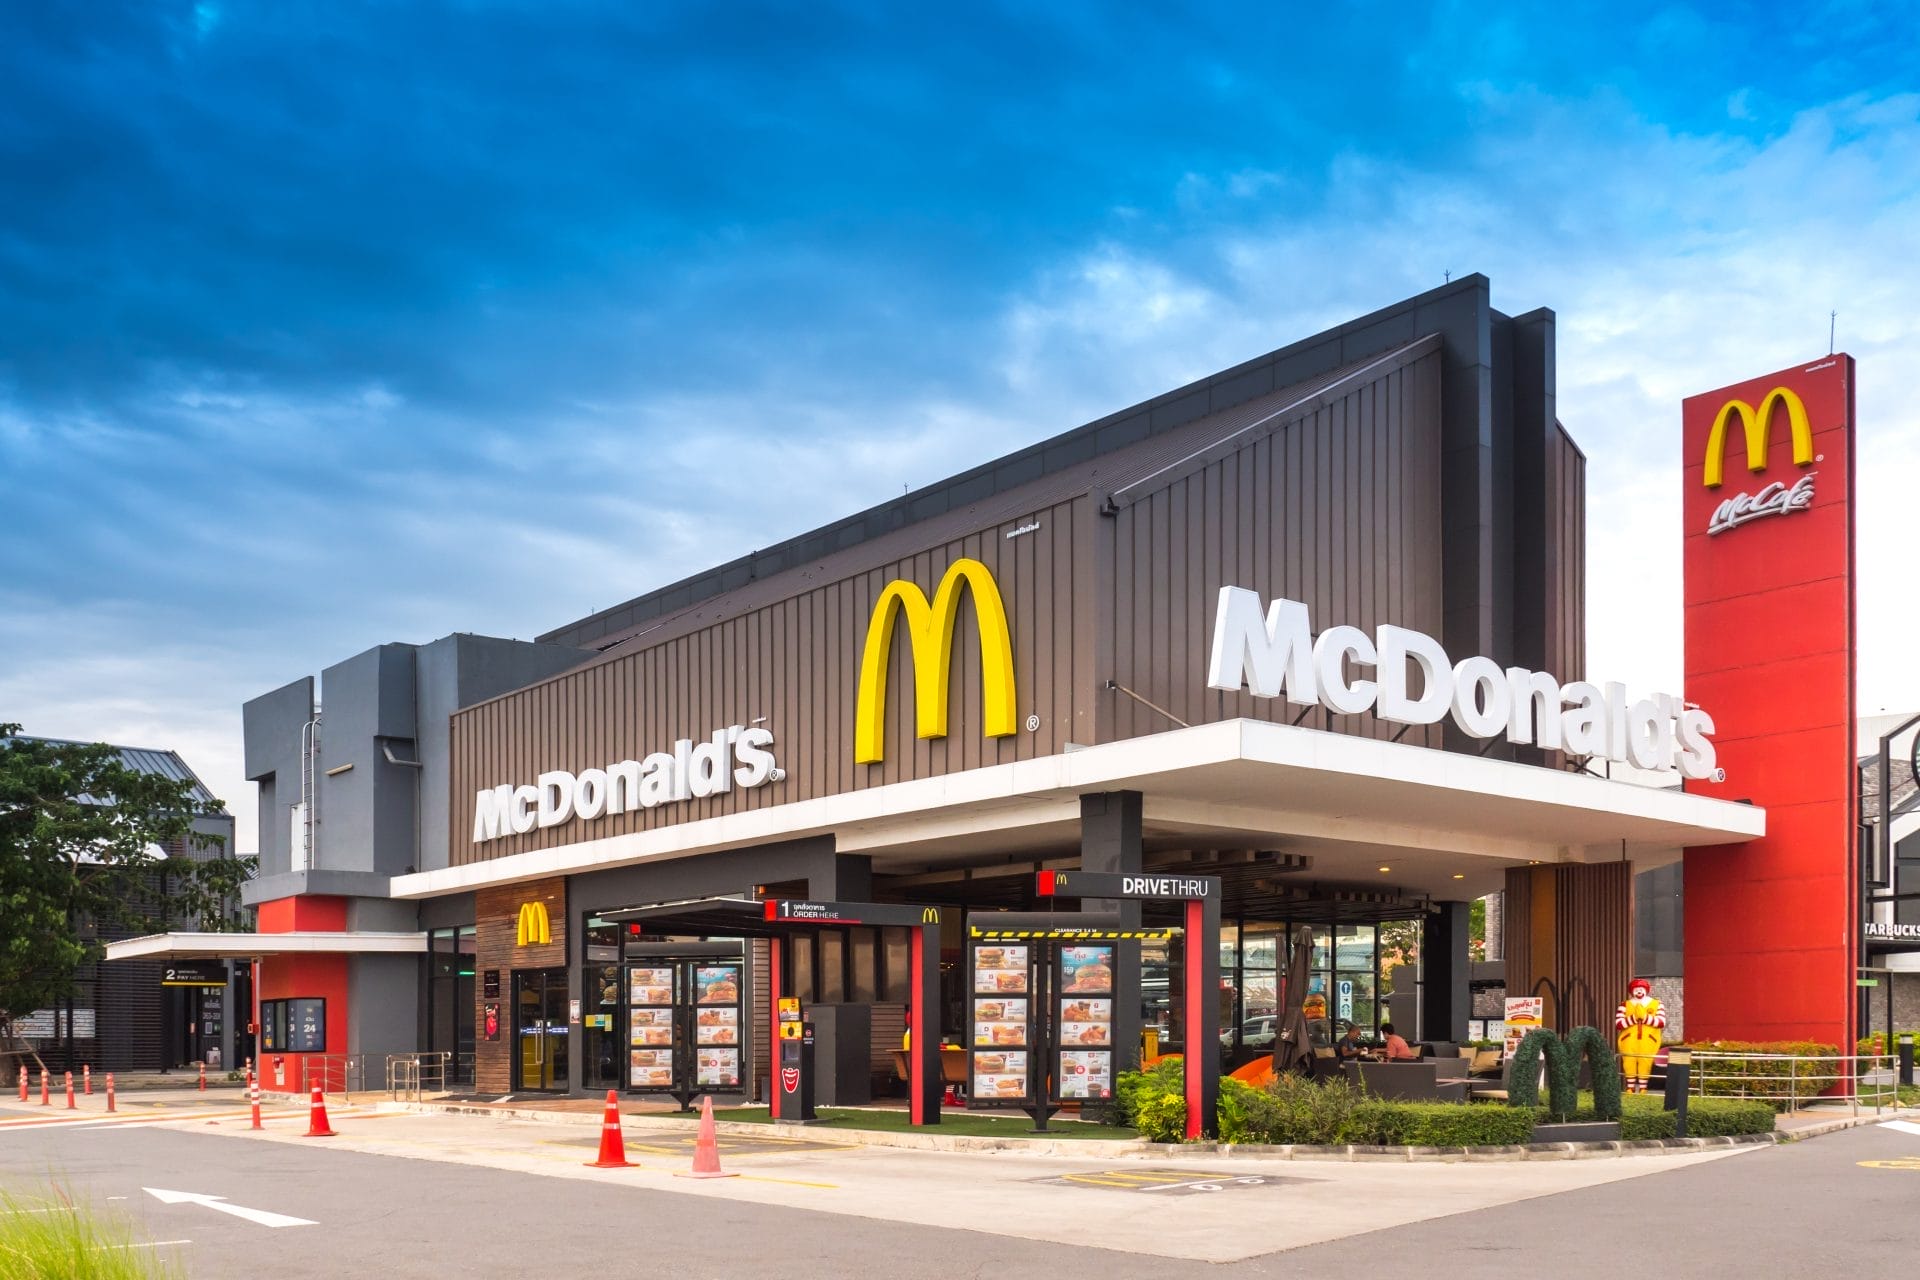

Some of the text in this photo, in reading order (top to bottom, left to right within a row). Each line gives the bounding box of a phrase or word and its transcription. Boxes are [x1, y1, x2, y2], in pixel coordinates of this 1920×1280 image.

[1207, 585, 1717, 780] McDonald's
[473, 724, 776, 843] McDonald's
[781, 901, 789, 917] 1
[819, 911, 839, 919] HERE
[165, 969, 176, 980] 2
